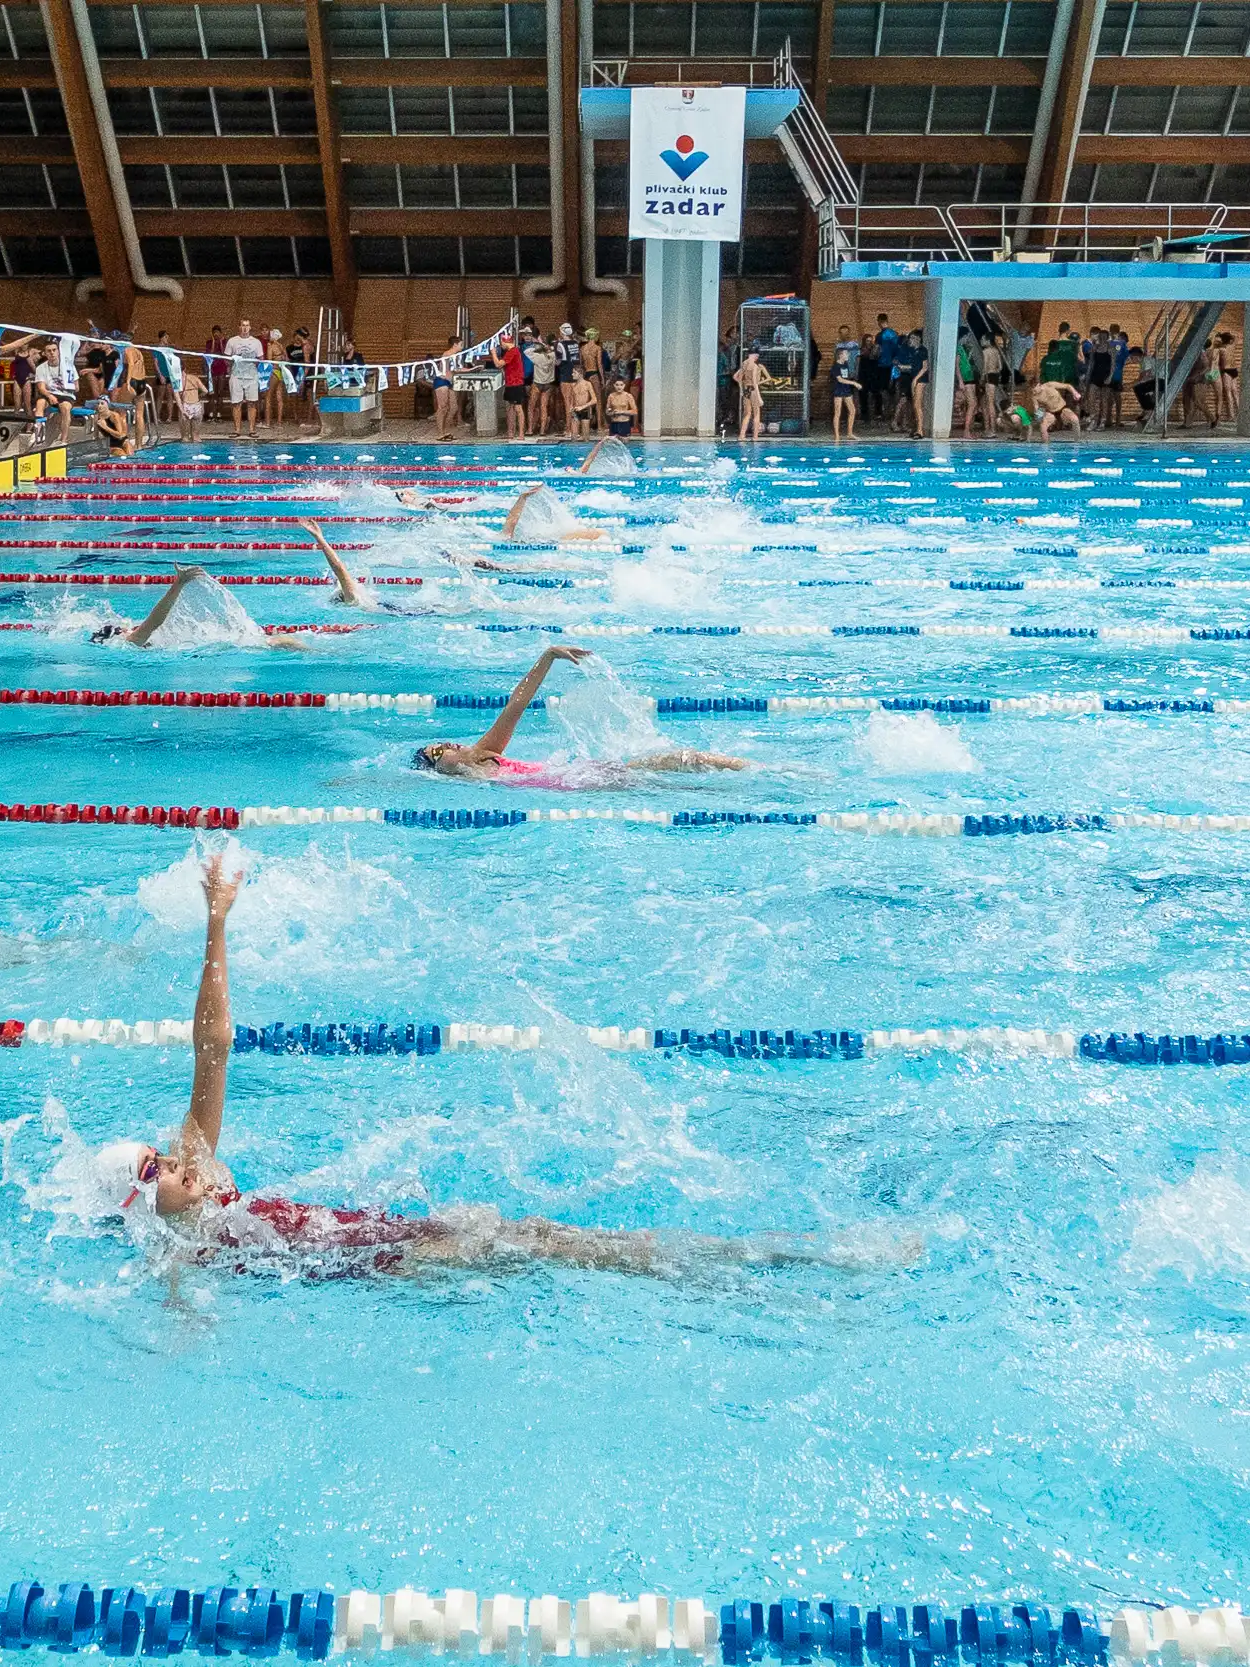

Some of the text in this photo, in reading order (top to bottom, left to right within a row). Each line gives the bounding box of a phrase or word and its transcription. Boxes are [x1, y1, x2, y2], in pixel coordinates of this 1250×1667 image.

[645, 184, 728, 196] plivački klub
[645, 198, 726, 216] zadar
